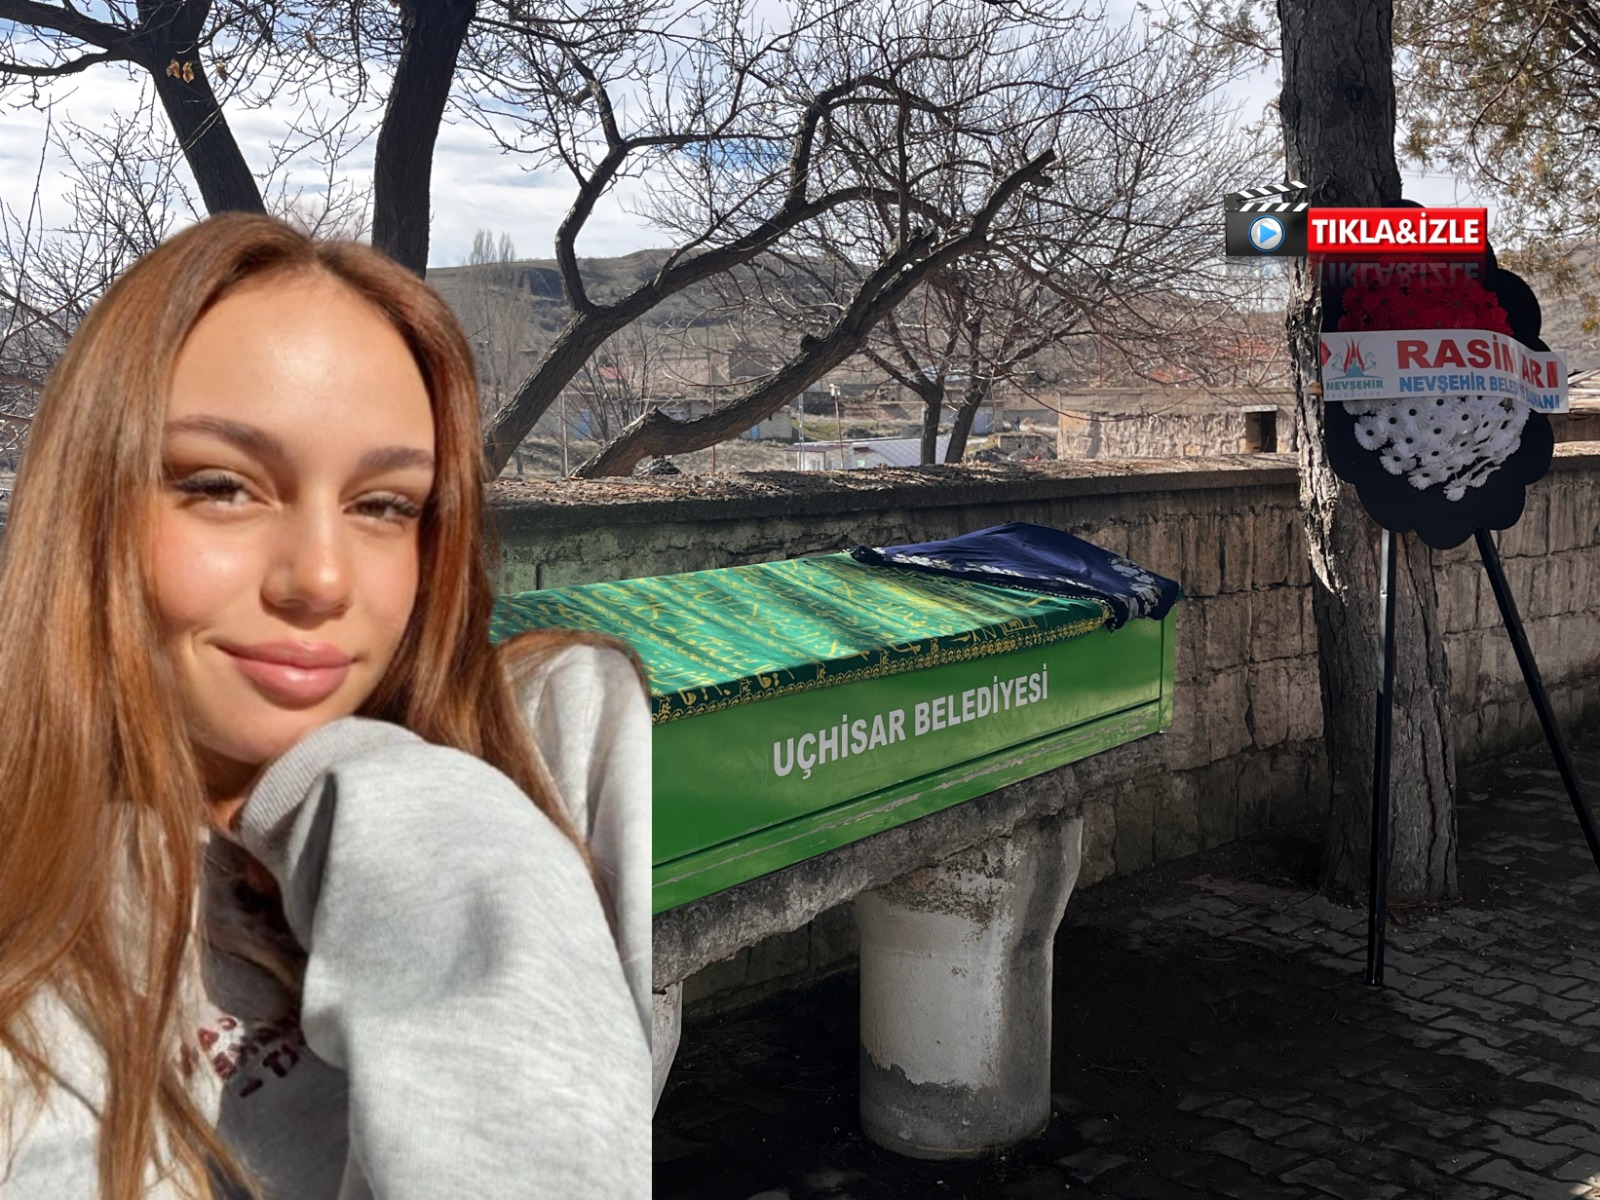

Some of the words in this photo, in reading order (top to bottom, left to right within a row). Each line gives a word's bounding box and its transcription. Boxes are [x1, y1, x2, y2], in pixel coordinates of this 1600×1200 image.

[1399, 371, 1486, 394] NEVŞEHİR
[1521, 354, 1559, 388] ARI
[1326, 379, 1384, 392] NEVŞEHİR
[773, 708, 906, 780] UÇHİSAR
[914, 663, 1048, 737] BELEDİYESİ
